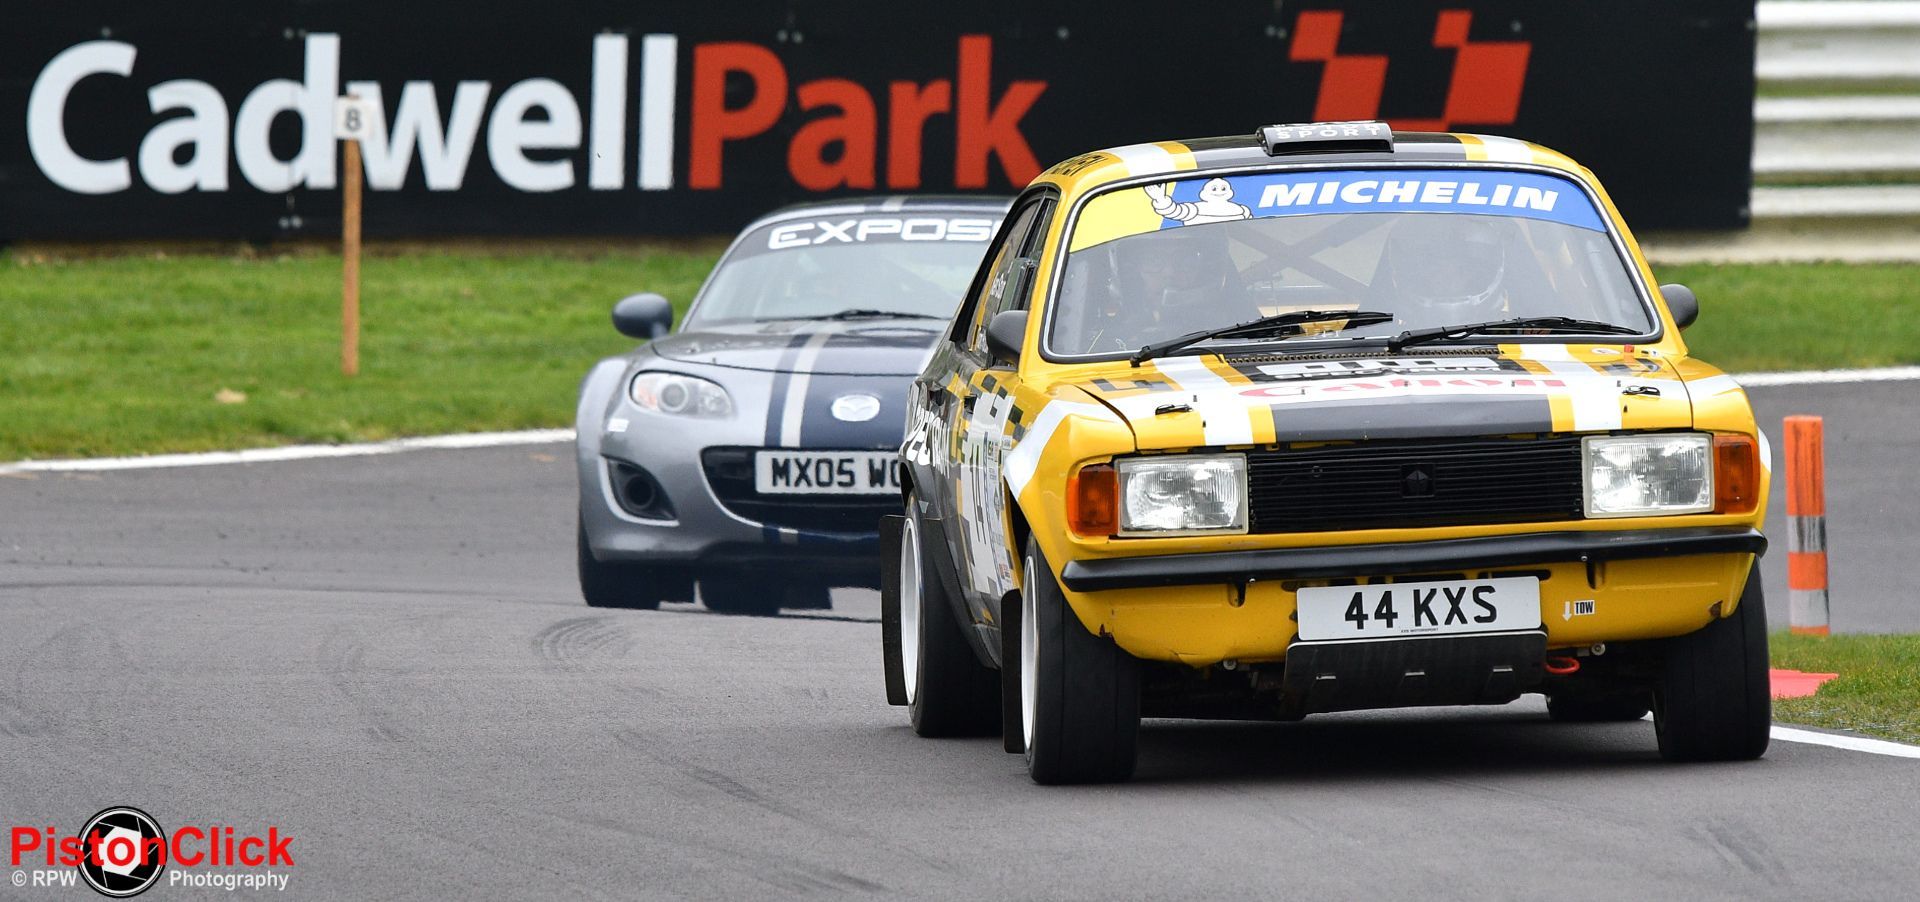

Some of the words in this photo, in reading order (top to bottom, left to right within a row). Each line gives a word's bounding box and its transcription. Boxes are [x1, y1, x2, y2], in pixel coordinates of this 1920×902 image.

[344, 107, 362, 131] 8
[1276, 129, 1381, 139] SPORT
[1258, 181, 1559, 211] MICHELIN
[768, 219, 1003, 250] EXPOS
[1238, 378, 1567, 397] Canon
[771, 458, 856, 487] MX05
[1344, 591, 1398, 629] 44
[1413, 585, 1497, 627] KXS
[1575, 601, 1594, 614] TOW
